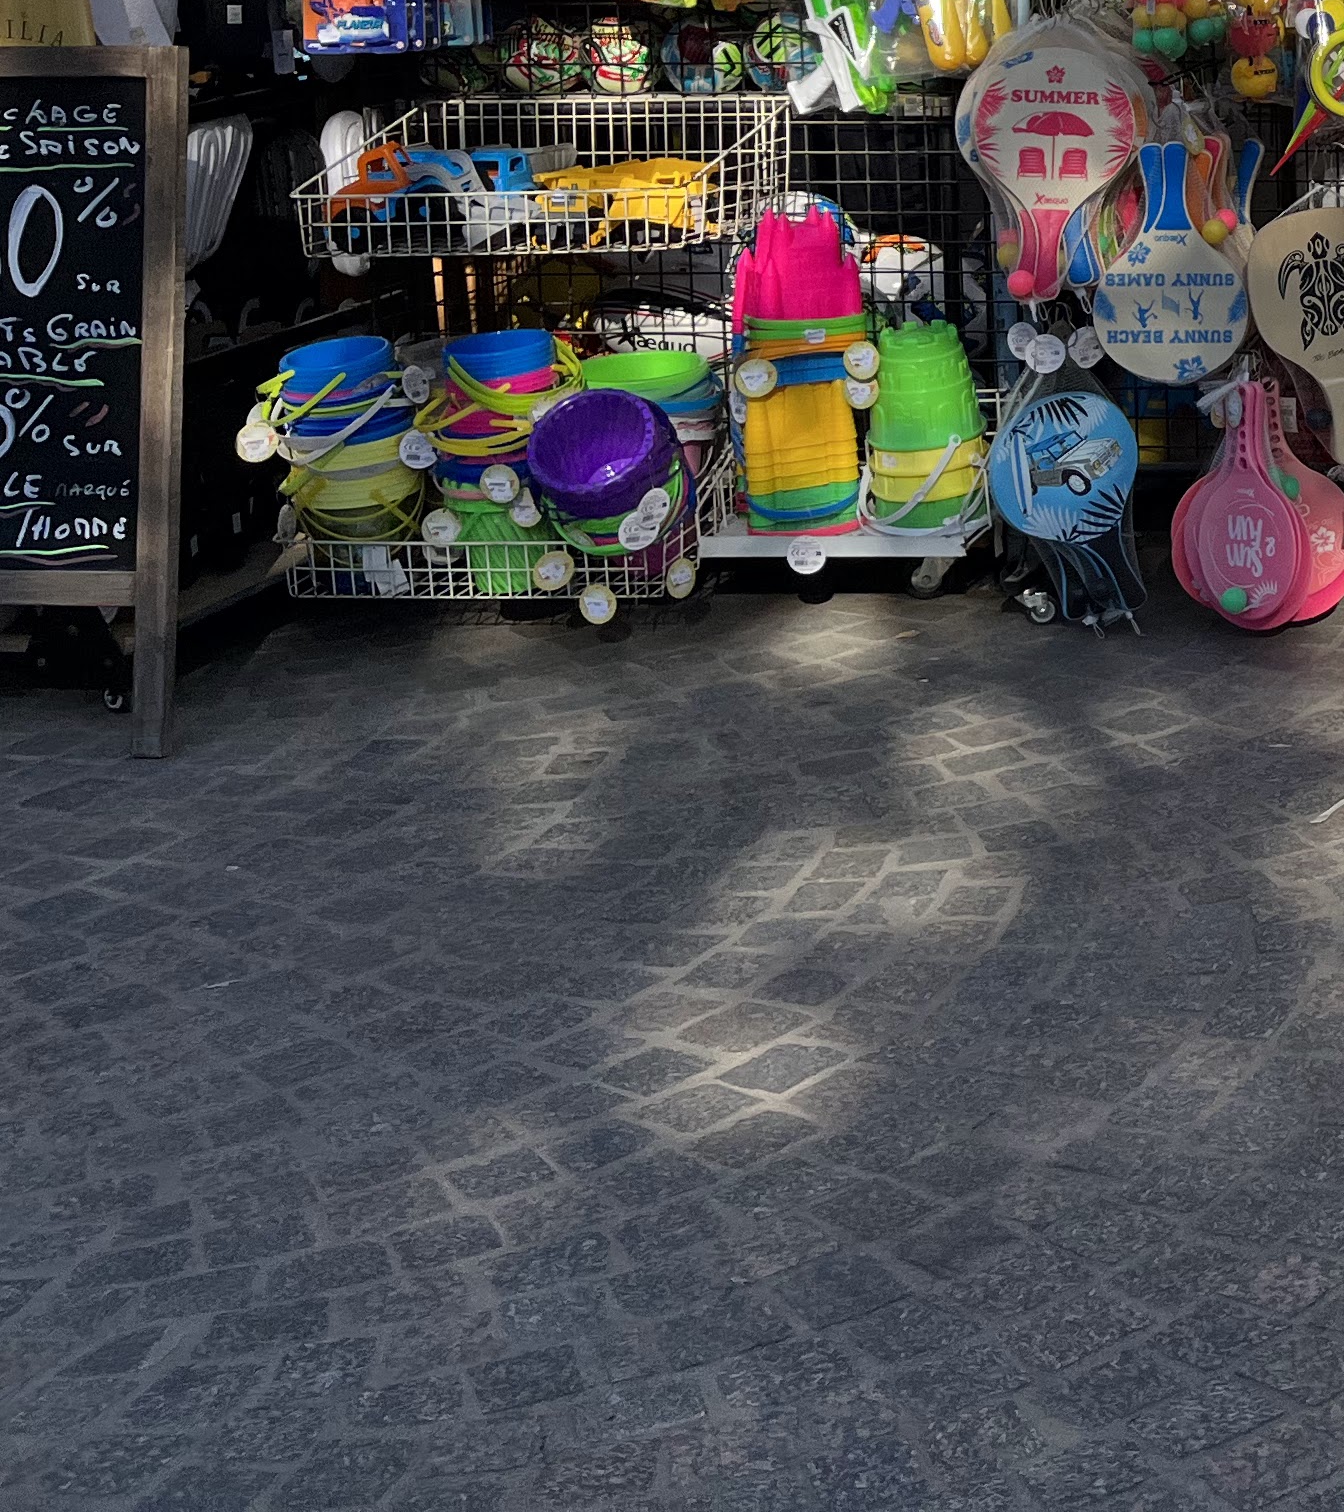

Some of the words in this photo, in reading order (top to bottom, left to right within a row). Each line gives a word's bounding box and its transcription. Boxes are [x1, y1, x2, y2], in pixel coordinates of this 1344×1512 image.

[1011, 89, 1100, 105] SUMMER
[1171, 272, 1235, 287] SUNNY
[1106, 329, 1164, 344] BEACH
[1169, 329, 1233, 344] SUNNY
